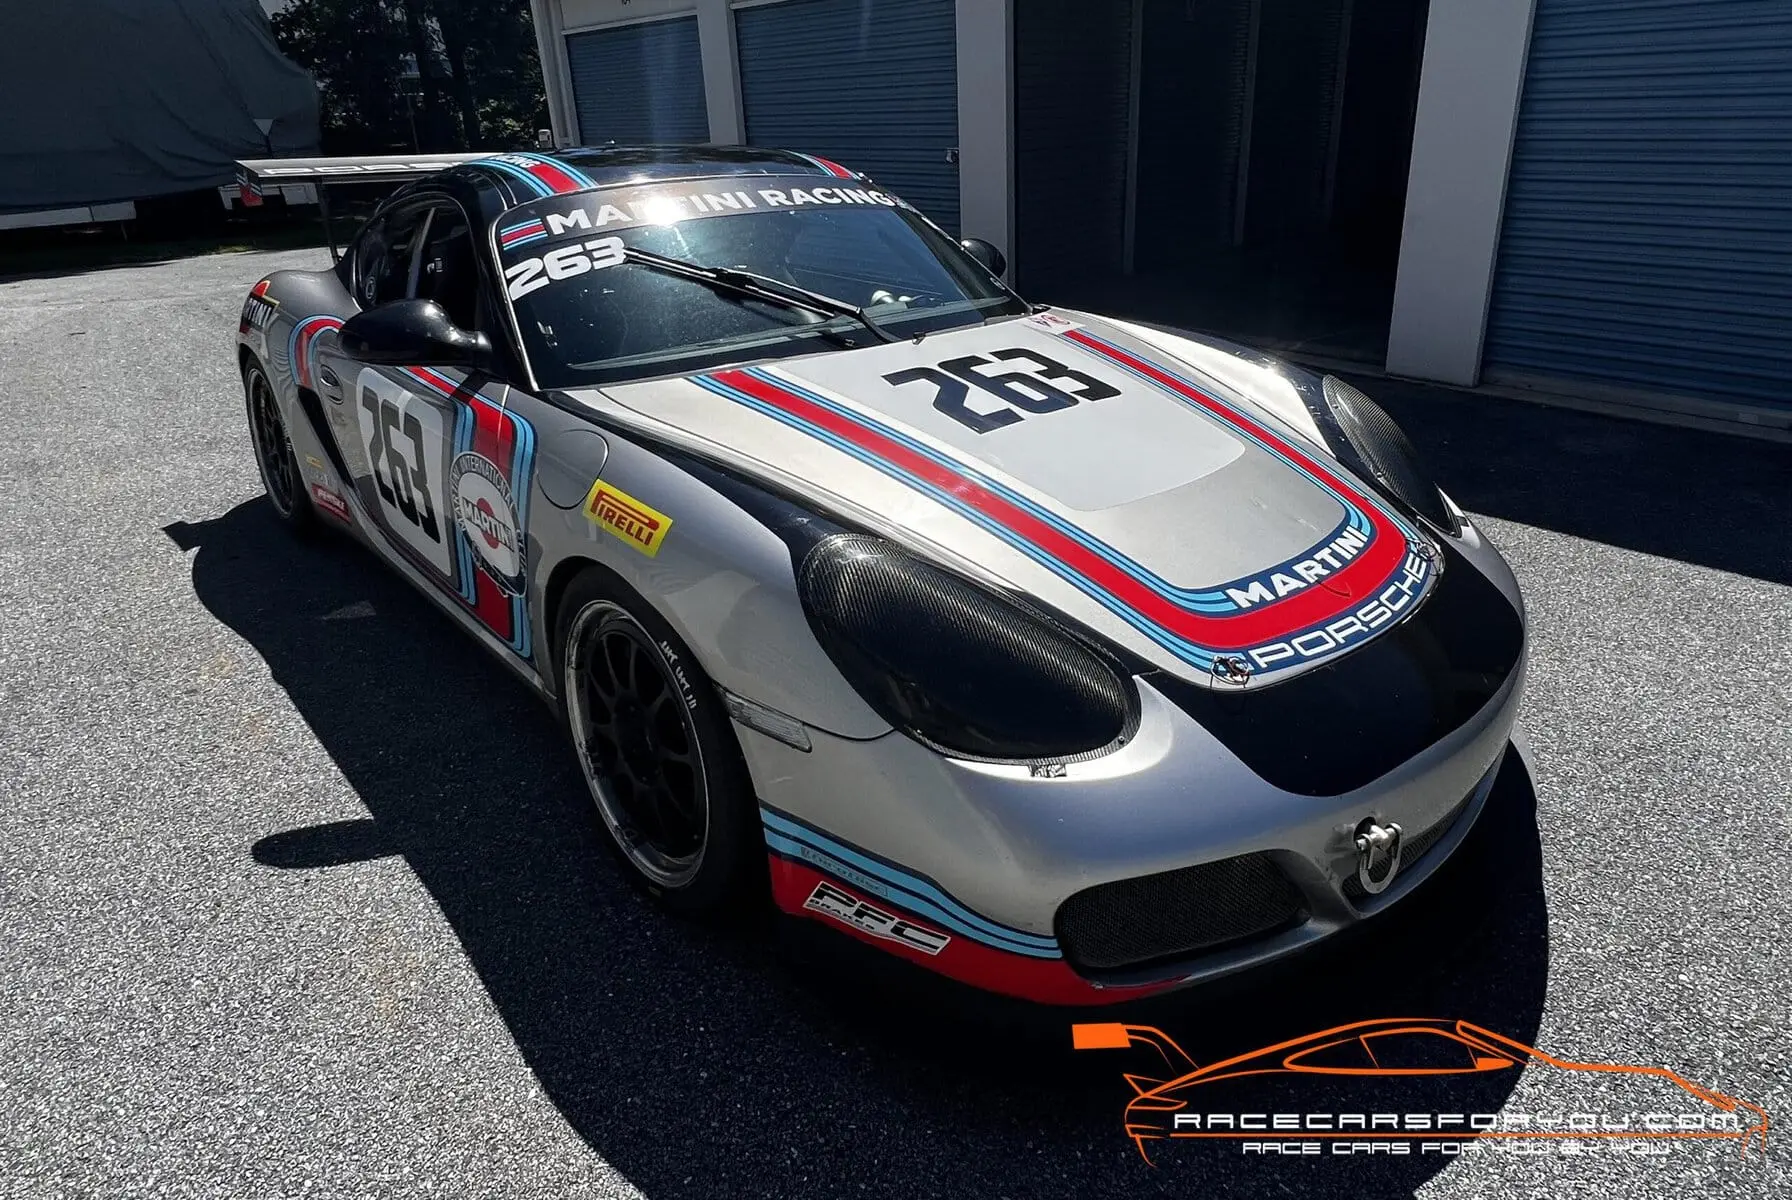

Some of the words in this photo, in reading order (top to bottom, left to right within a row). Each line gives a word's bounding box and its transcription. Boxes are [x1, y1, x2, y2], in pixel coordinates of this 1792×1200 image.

[546, 190, 757, 236] MAINI
[757, 187, 896, 208] RACING
[505, 236, 626, 301] 263
[882, 347, 1122, 434] 263
[363, 385, 440, 543] 263
[462, 498, 515, 550] MARTINI
[590, 489, 660, 546] PIRELLI
[1227, 526, 1369, 609] MARTINI
[1248, 552, 1427, 668] PORSCHE
[809, 881, 949, 950] PFC
